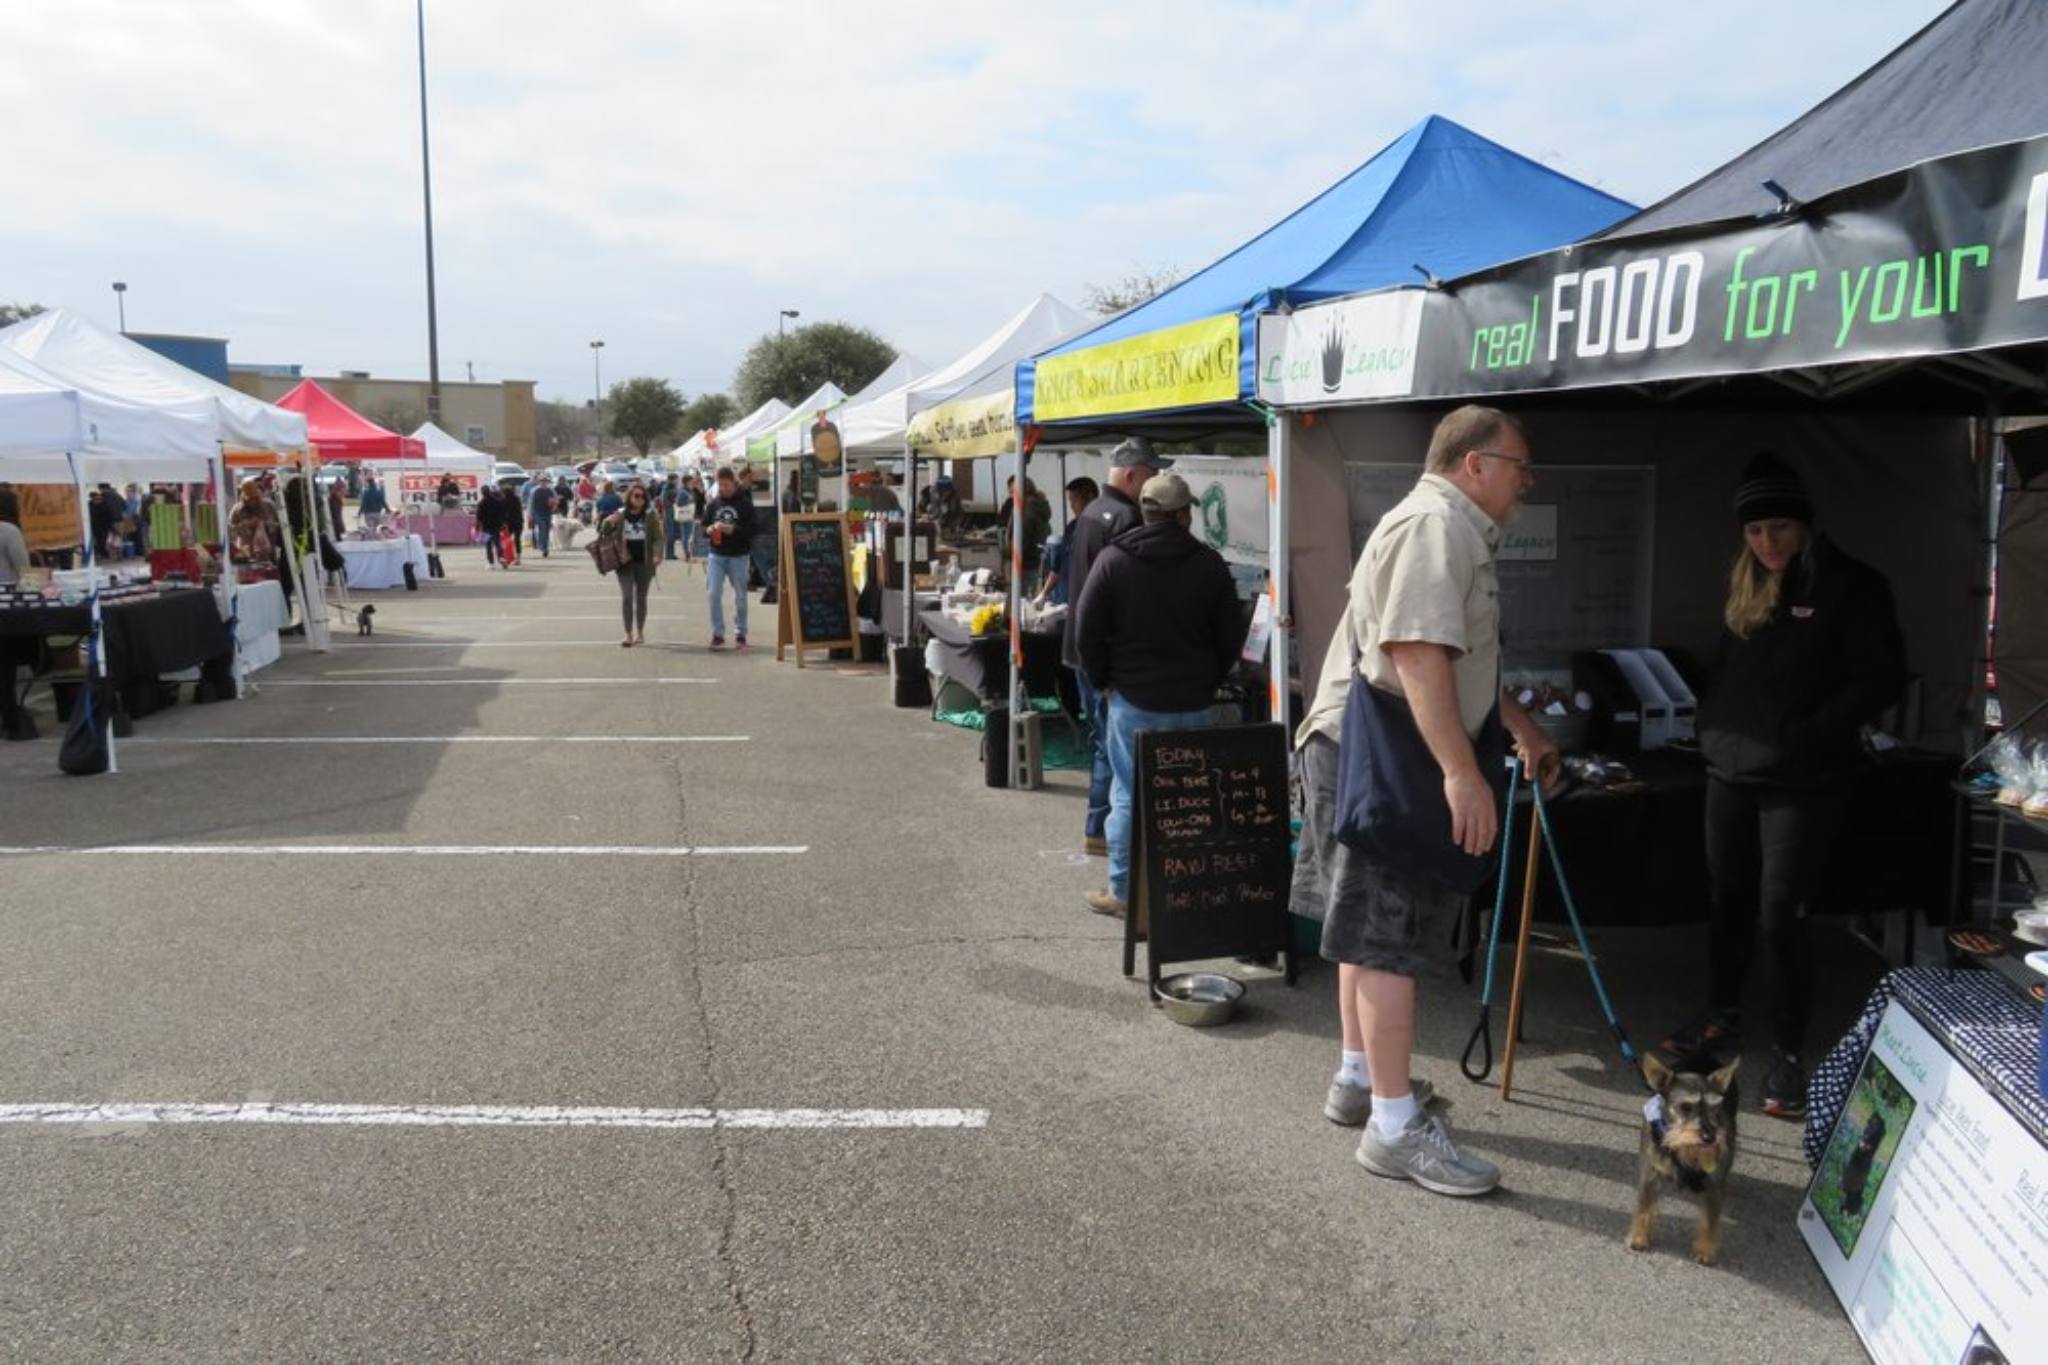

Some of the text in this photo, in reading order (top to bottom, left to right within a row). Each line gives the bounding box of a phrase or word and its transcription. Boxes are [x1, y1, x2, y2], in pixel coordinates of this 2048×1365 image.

[1470, 245, 1990, 371] real FOOD for your
[1088, 337, 1235, 397] SHARPENING
[404, 476, 472, 490] TEXS
[1503, 531, 1557, 559] Legacy
[1155, 747, 1206, 771] TODAY
